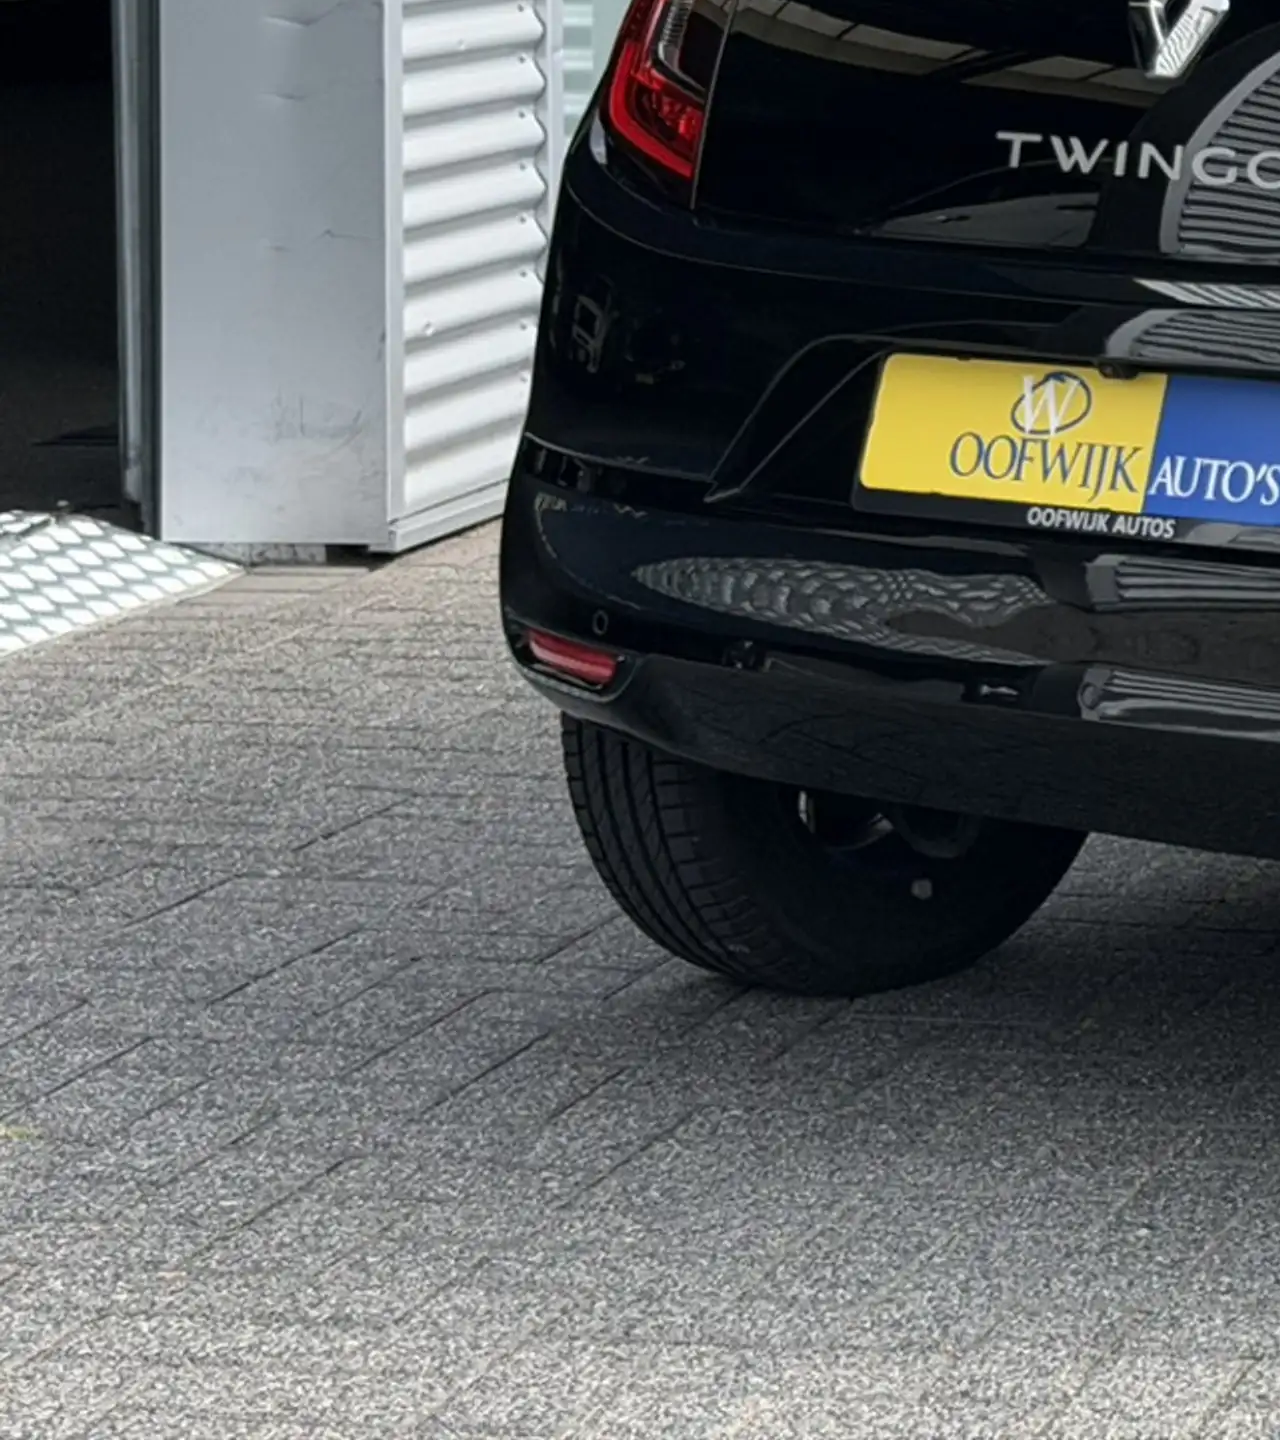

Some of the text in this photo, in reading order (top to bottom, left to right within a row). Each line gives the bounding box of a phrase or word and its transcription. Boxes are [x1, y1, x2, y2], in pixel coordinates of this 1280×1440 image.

[950, 432, 1144, 502] OOFWIJK
[1027, 506, 1176, 540] OOFWIJK AUTOS
